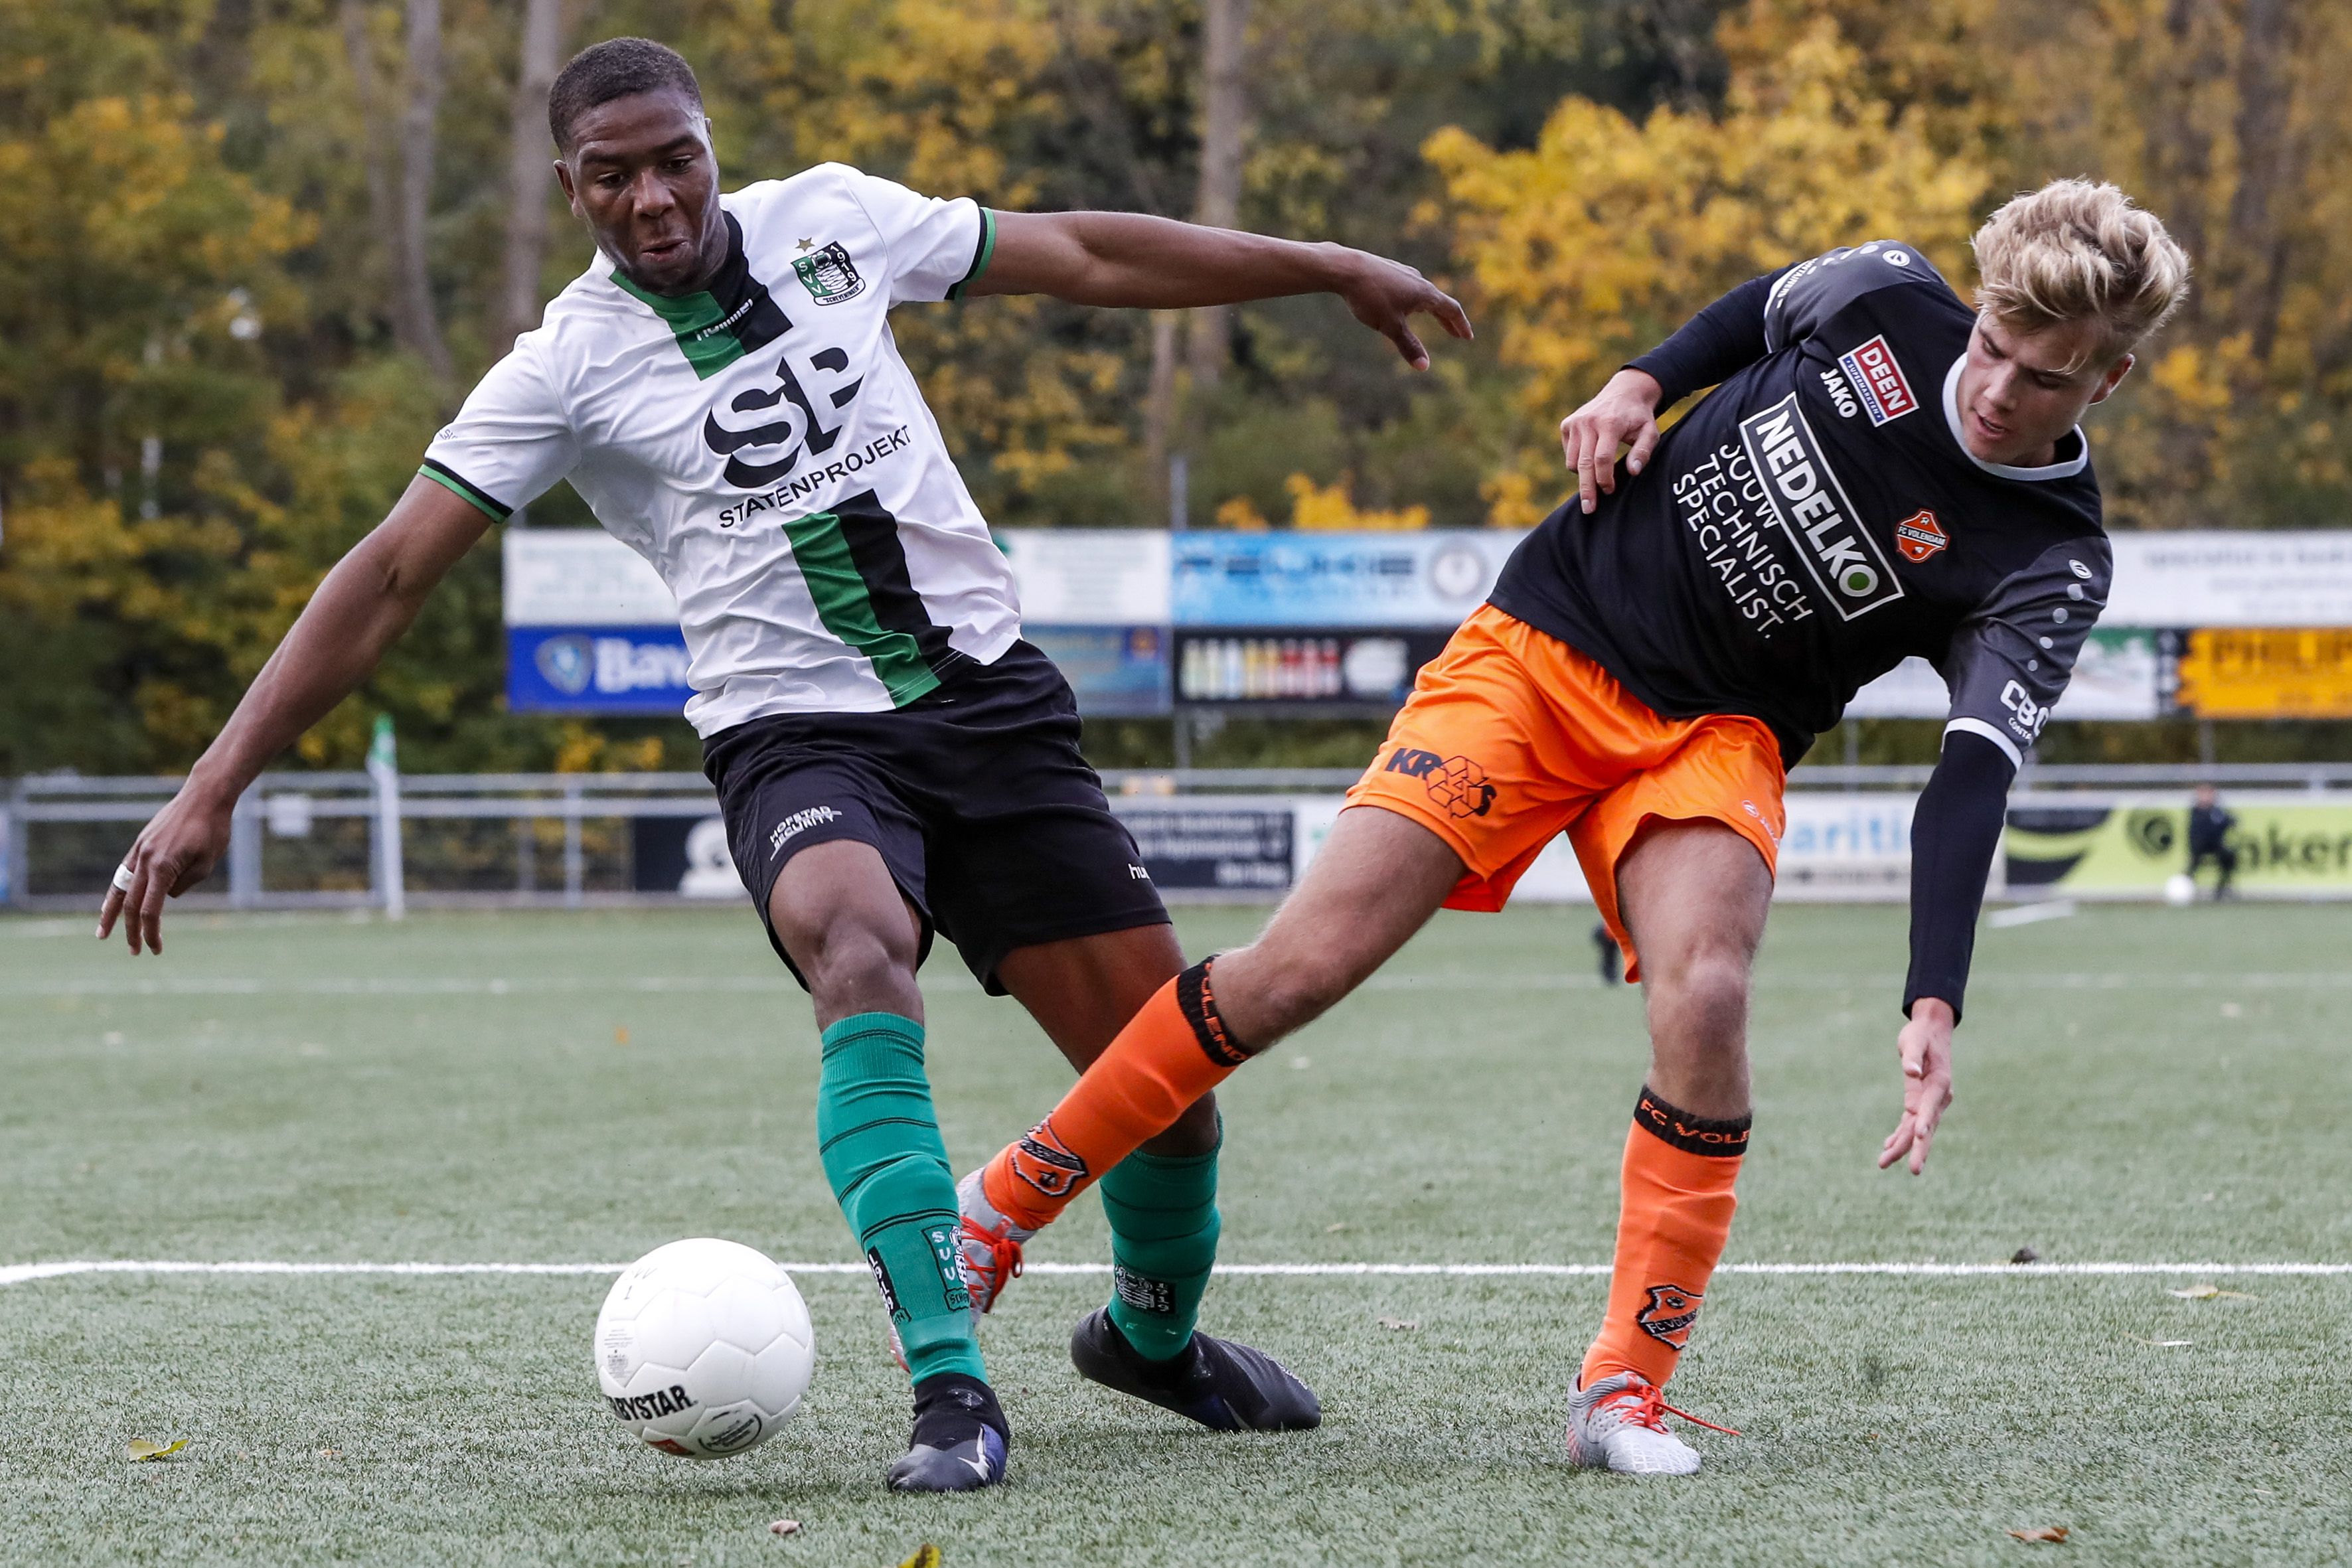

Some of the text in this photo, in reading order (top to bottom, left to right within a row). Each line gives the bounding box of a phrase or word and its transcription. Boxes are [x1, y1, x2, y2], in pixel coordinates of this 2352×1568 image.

[1820, 368, 1858, 418] JAKO
[1861, 347, 1907, 410] DEEN
[719, 425, 911, 528] STATENPROJEKT
[1719, 444, 1780, 530] JOUW
[1756, 410, 1879, 597] NEDELKO
[1694, 453, 1814, 621] TECHNISCH
[1128, 863, 1150, 880] hu
